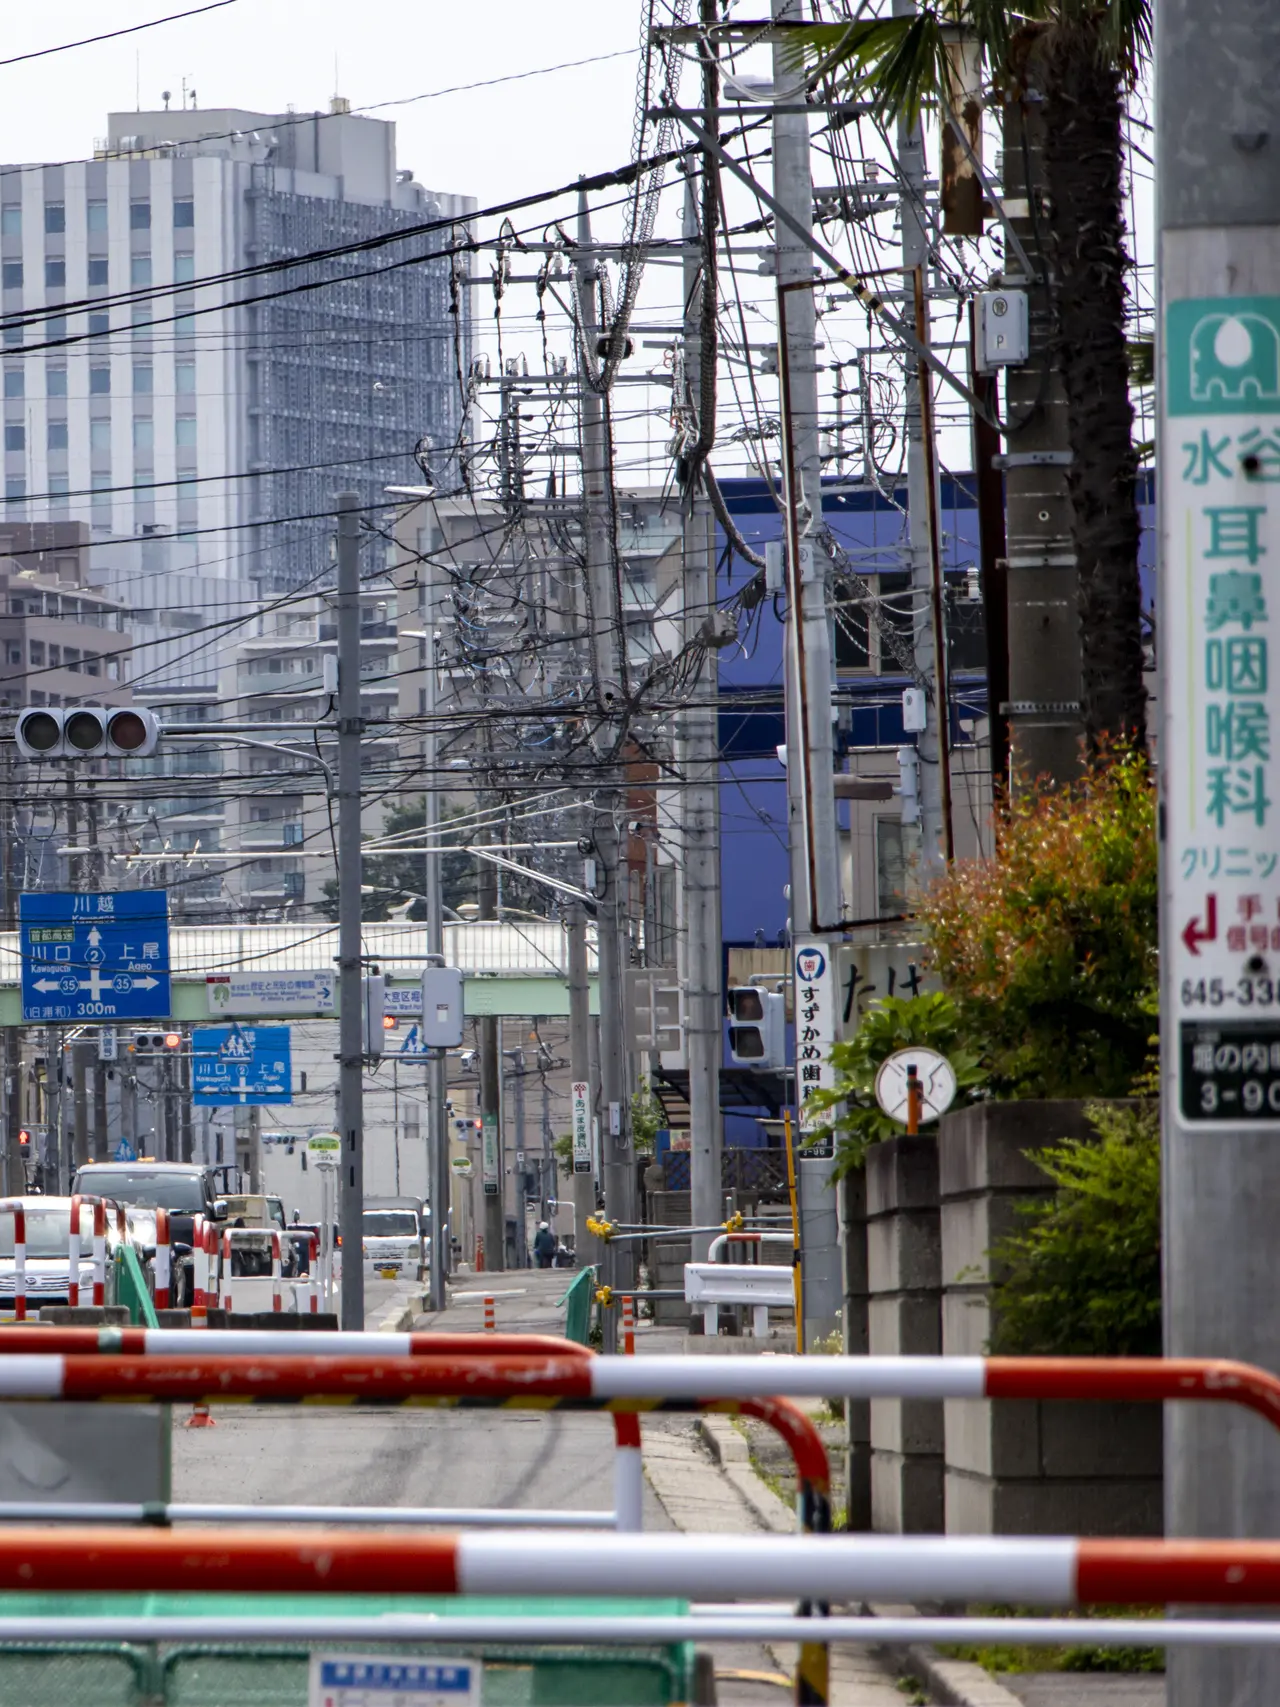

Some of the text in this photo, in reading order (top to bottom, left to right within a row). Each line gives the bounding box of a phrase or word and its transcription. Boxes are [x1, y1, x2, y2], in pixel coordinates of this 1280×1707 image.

[1203, 504, 1272, 828] 耳鼻咽喉科
[73, 895, 115, 914] 川越
[31, 945, 71, 962] 川口
[90, 950, 99, 963] 2
[119, 942, 160, 960] 上尾
[63, 978, 77, 992] 35
[116, 977, 130, 990] 35
[1181, 978, 1280, 1008] 645-33
[77, 1002, 116, 1016] 300m
[199, 1063, 227, 1075] 川口
[239, 1066, 245, 1075] 2
